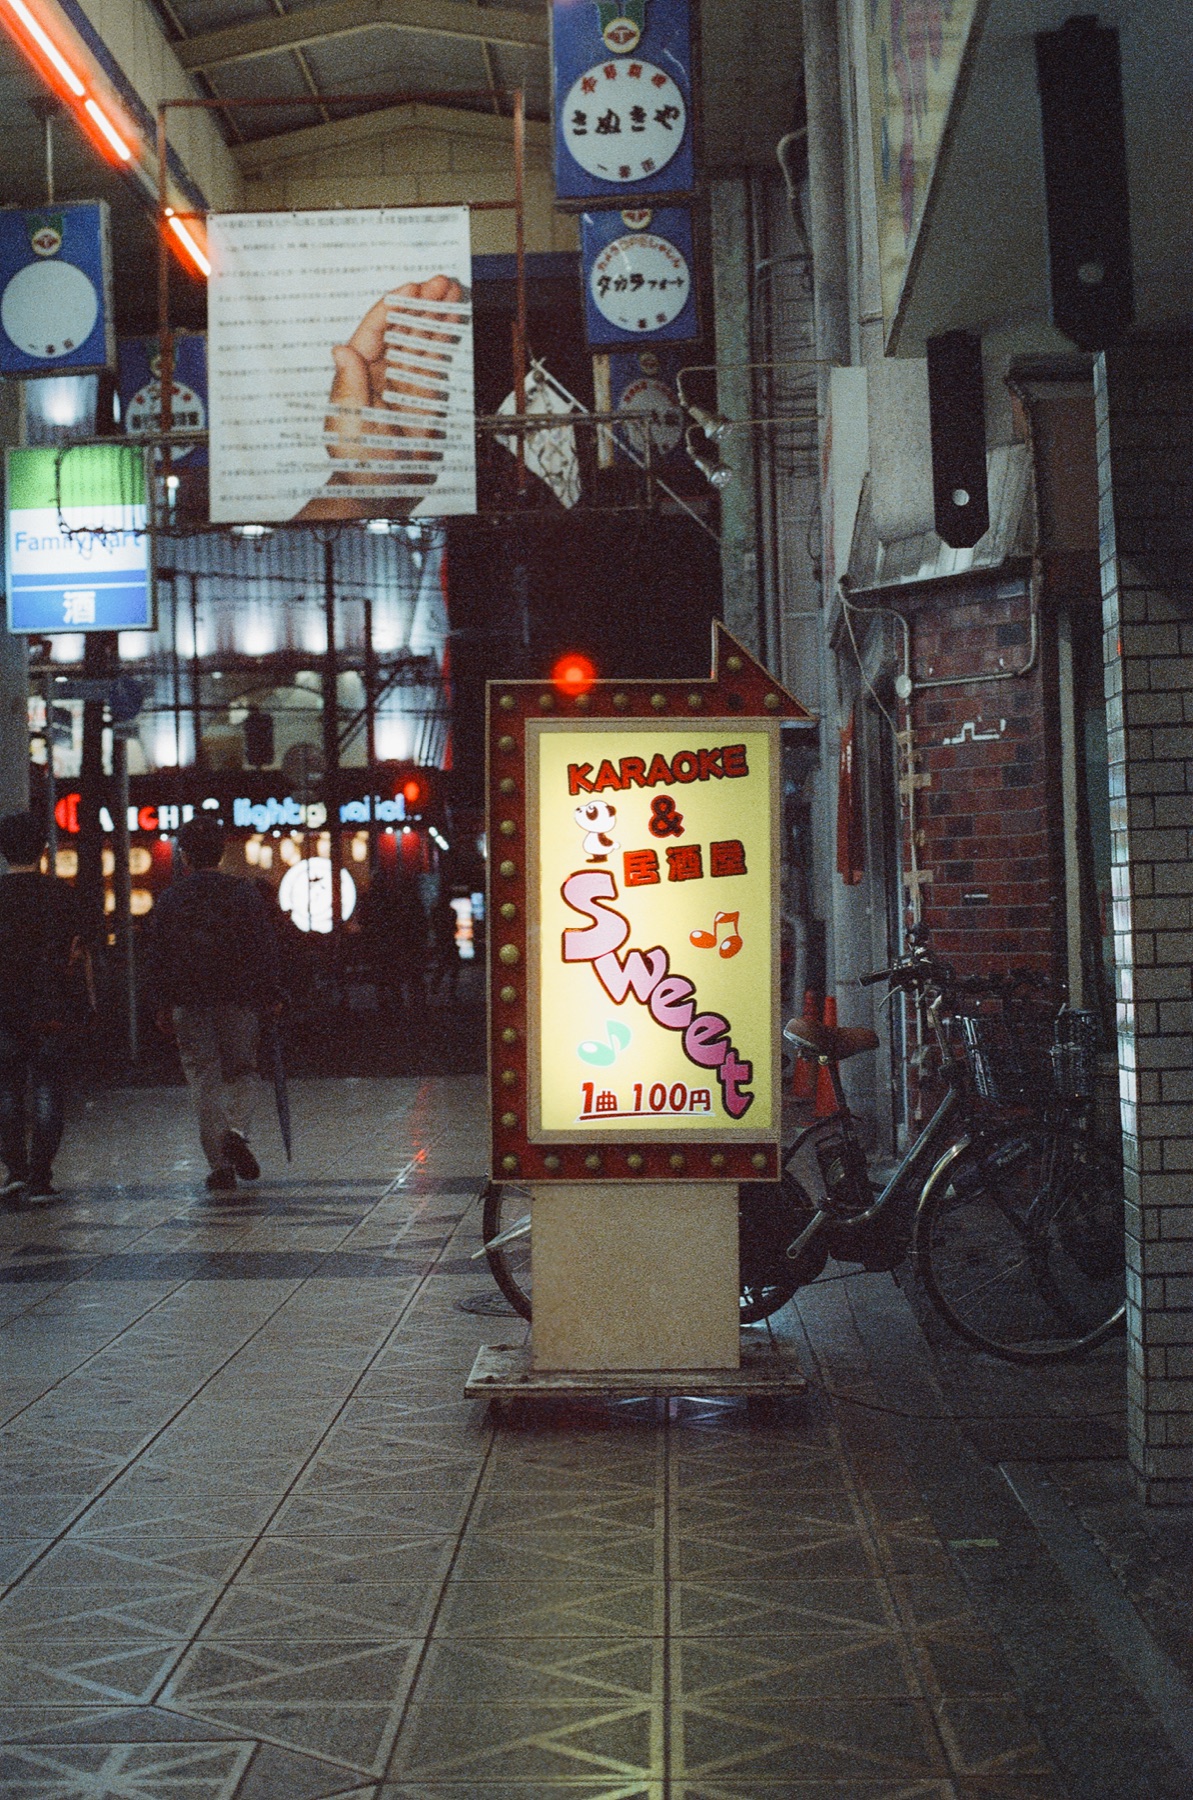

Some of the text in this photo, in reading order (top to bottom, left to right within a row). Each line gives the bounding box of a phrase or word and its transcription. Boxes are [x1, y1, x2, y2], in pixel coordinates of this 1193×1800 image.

[63, 591, 96, 624] 酒
[567, 744, 748, 795] KARAOKE
[648, 795, 685, 838] &
[623, 839, 748, 887] 居酒屋
[560, 869, 754, 1119] Sweet
[582, 1082, 712, 1114] 1曲 100円
